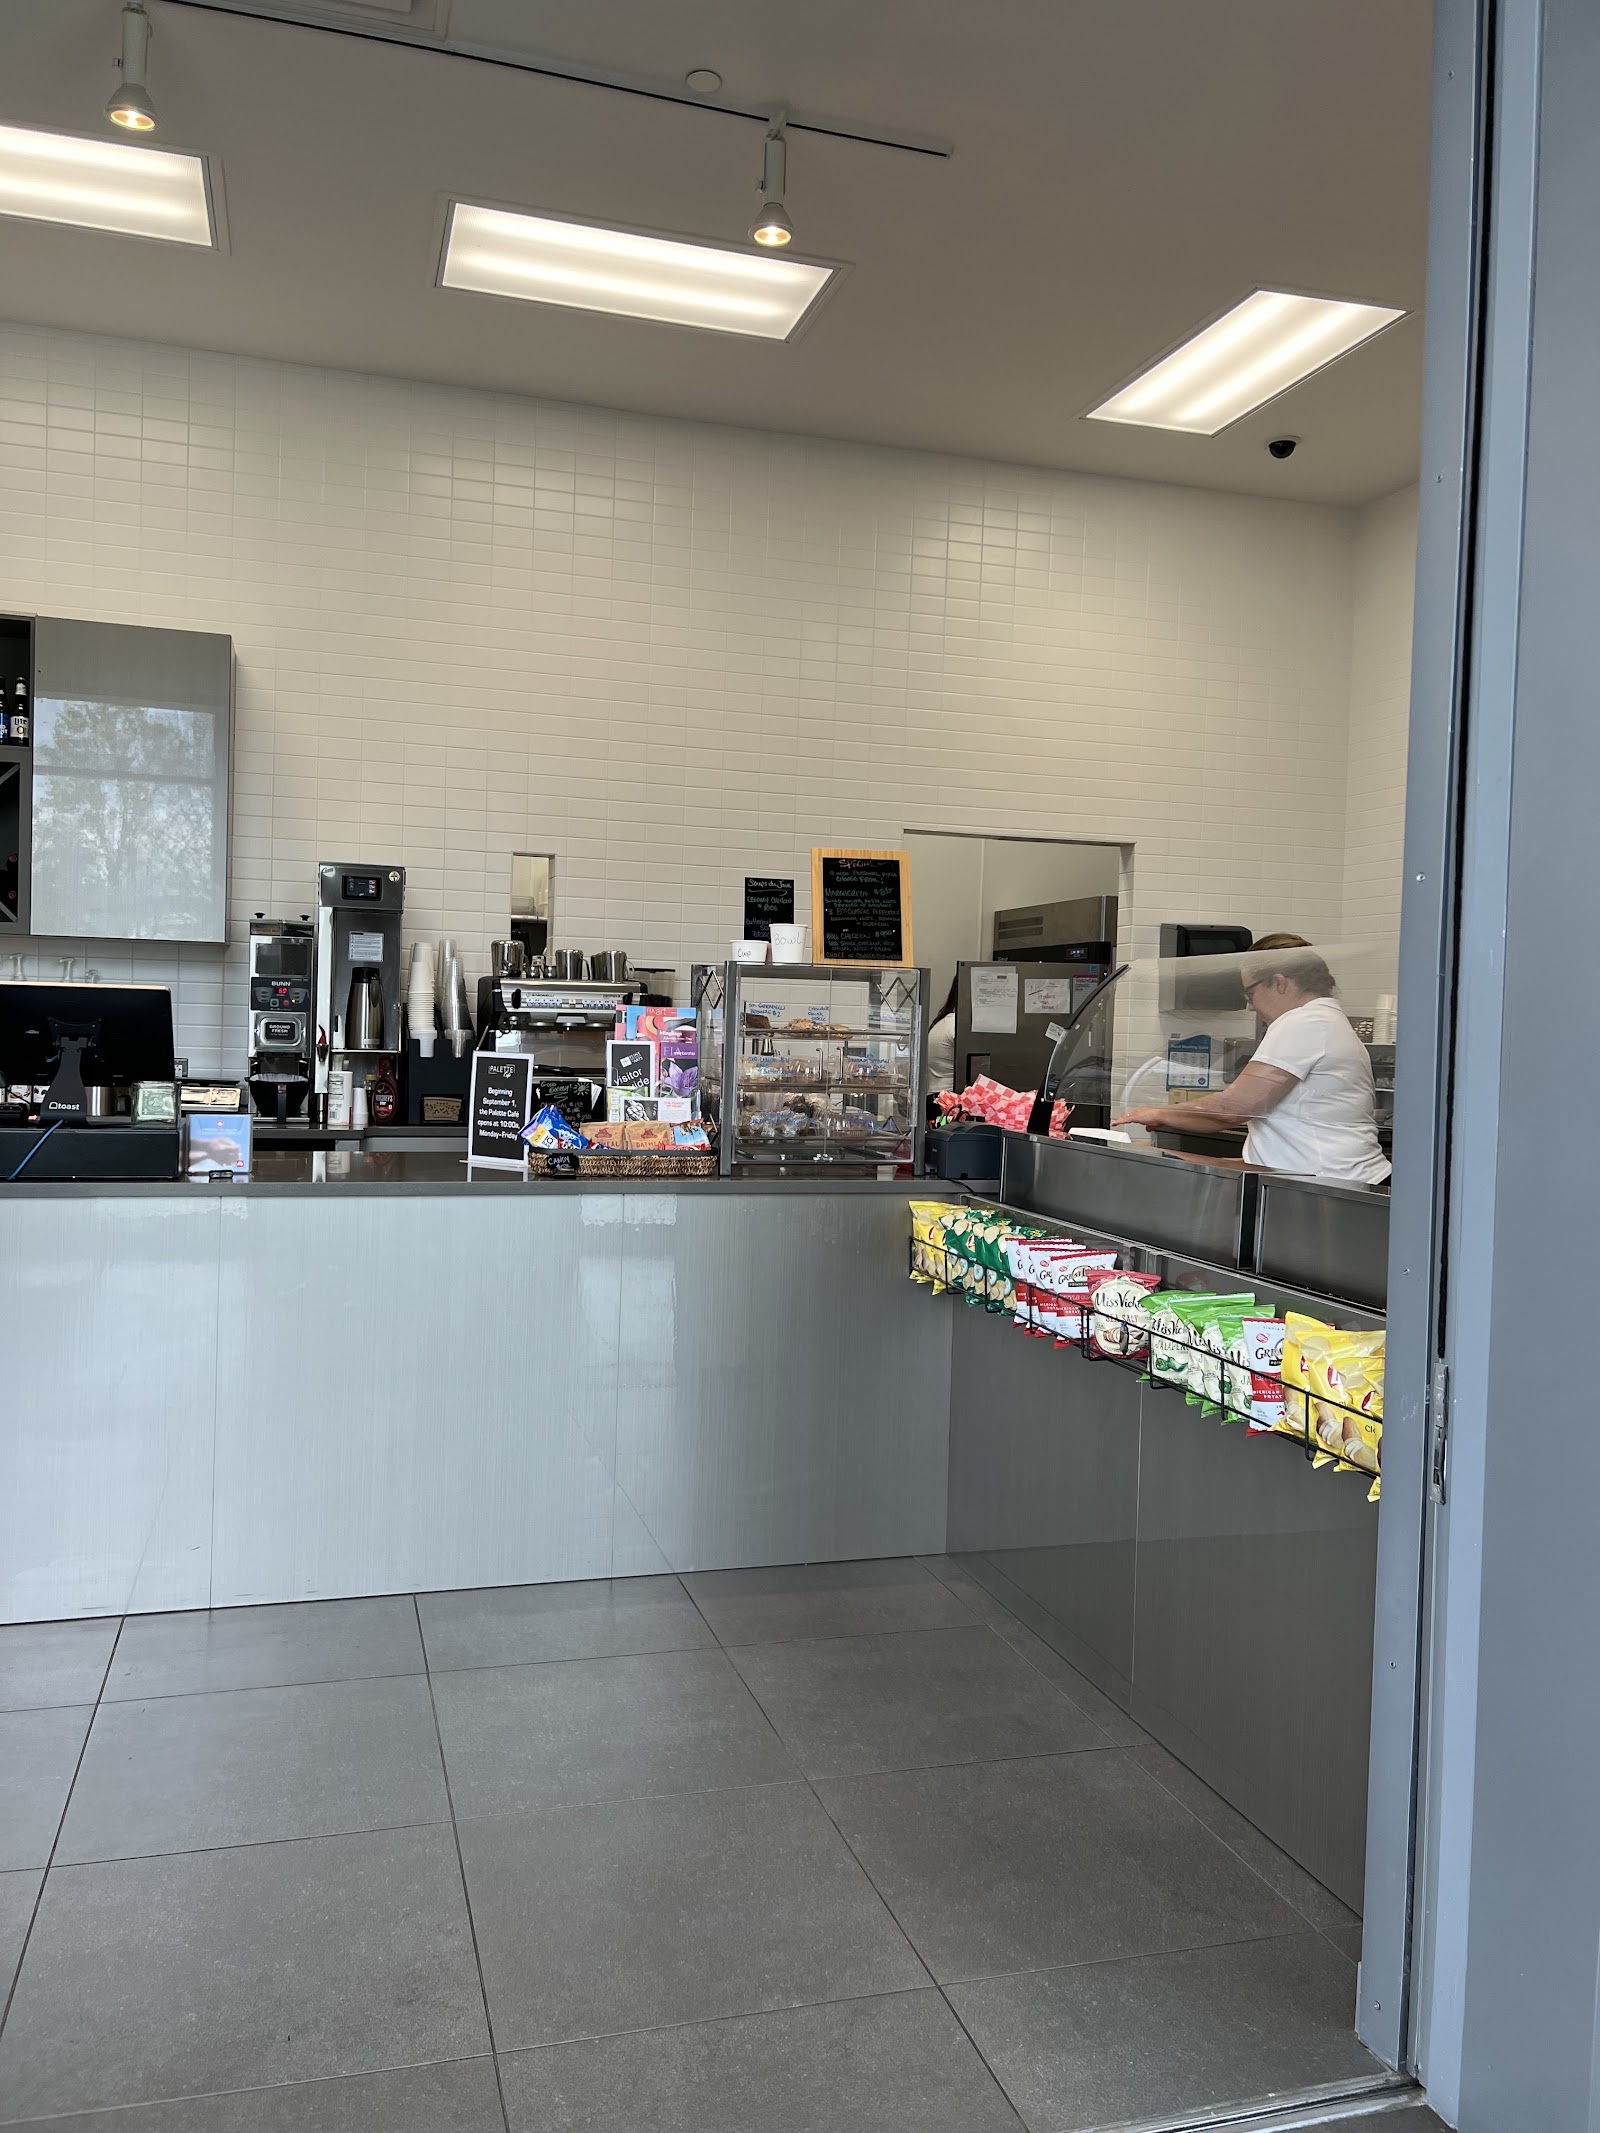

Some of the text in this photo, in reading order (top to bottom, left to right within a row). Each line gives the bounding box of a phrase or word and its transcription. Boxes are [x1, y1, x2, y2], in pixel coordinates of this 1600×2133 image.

[737, 948, 752, 958] Cup
[488, 1064, 514, 1074] PALETTE
[614, 1068, 642, 1086] visitor
[488, 1087, 513, 1097] Beginning
[482, 1097, 510, 1106] September
[488, 1108, 507, 1117] Palette
[507, 1110, 519, 1118] Café
[548, 1156, 570, 1165] CANDY
[1096, 1292, 1118, 1308] Miss
[1122, 1314, 1138, 1323] SALT
